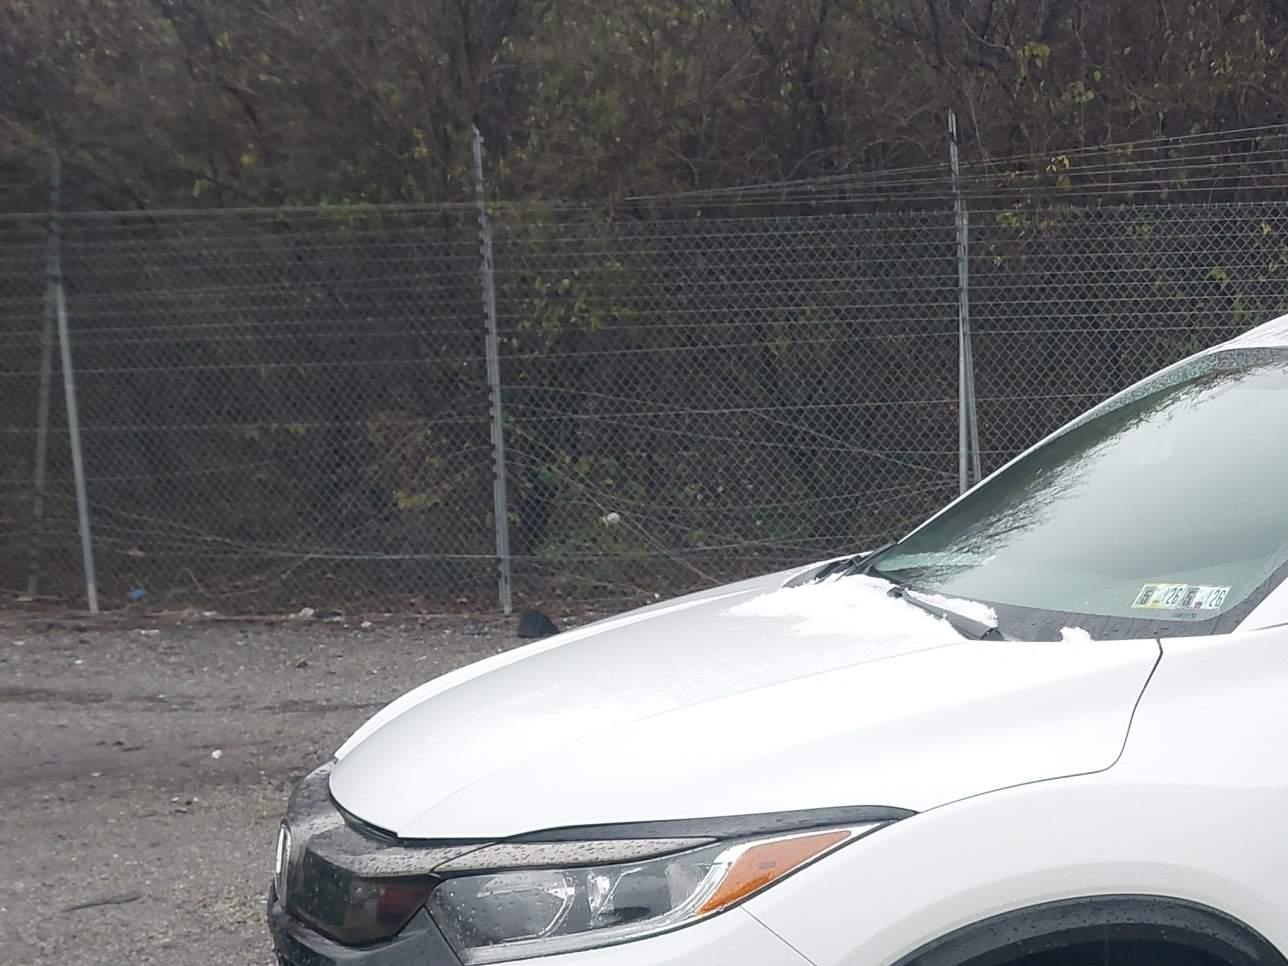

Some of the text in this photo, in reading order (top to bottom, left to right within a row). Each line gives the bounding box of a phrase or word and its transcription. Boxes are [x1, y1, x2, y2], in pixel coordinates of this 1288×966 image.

[1140, 587, 1183, 605] 5 26
[1183, 589, 1227, 607] 5 26
